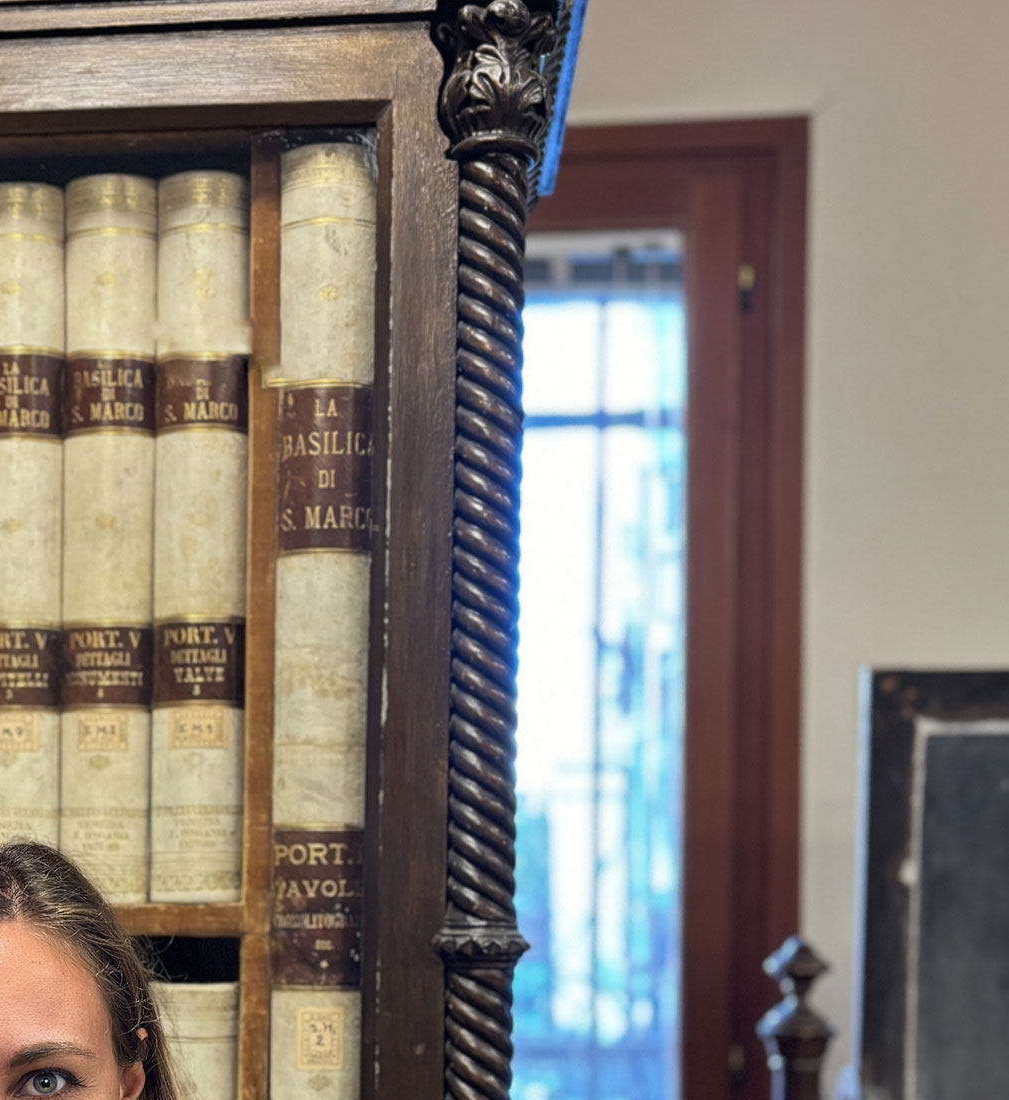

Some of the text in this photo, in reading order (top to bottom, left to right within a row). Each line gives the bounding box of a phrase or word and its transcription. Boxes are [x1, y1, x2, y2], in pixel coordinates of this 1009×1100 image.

[3, 361, 20, 376] LA
[90, 402, 144, 421] MARCO
[183, 402, 238, 421] MARCO
[315, 399, 337, 417] LA
[318, 469, 336, 488] DI
[281, 508, 297, 532] S.
